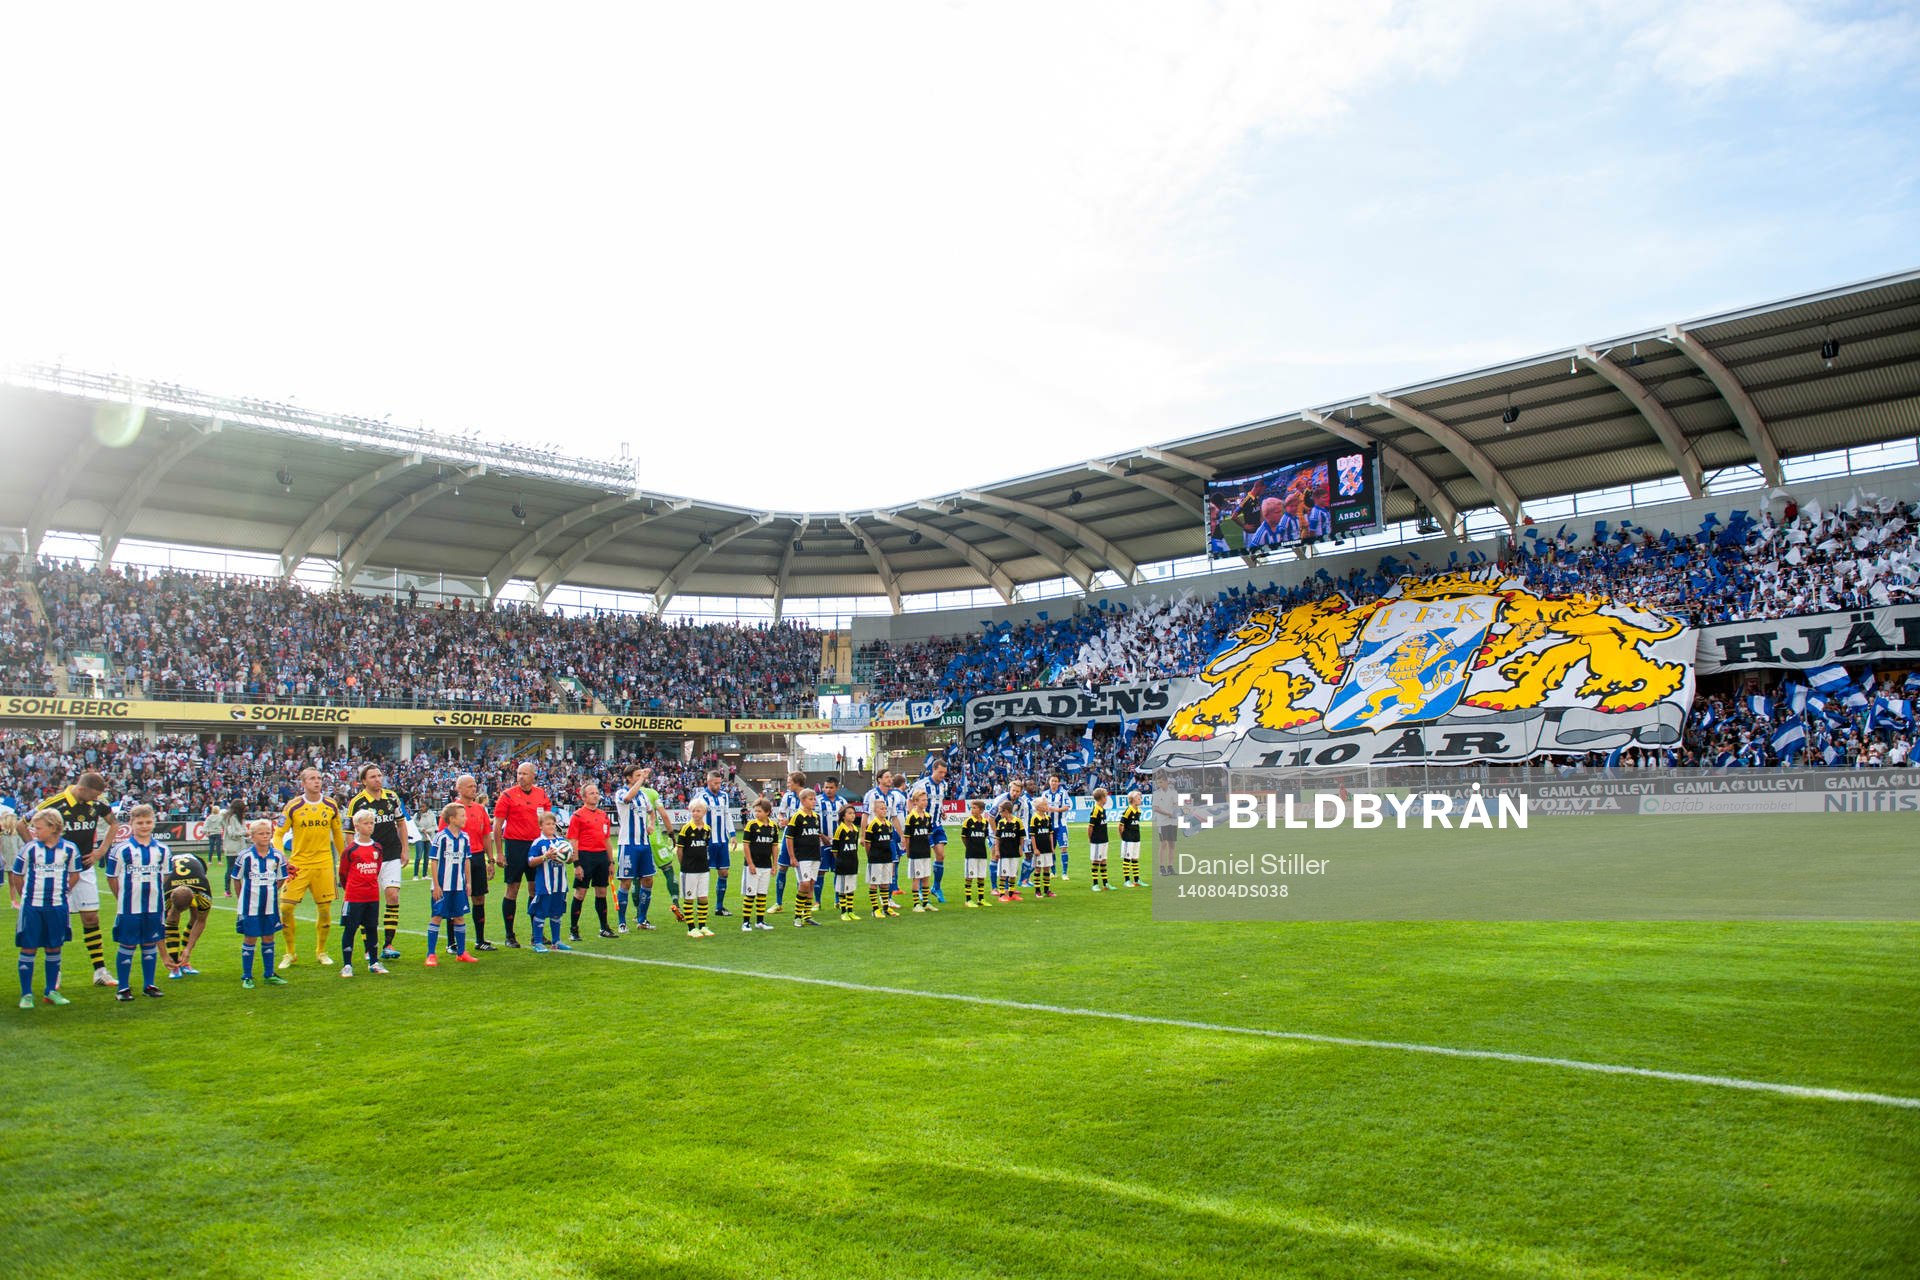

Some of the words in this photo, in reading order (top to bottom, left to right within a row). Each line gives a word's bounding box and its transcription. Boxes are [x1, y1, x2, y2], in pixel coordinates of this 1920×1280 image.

[7, 698, 129, 716] SOHLBERG
[972, 683, 1169, 725] STADENS
[250, 706, 351, 722] SOHLBERG
[450, 712, 532, 726] SOHLBERG
[615, 717, 683, 730] SOHLBERG
[1253, 743, 1361, 768] 110
[1373, 728, 1510, 758] ÅR
[1538, 785, 1592, 797] GAMLA
[1604, 783, 1656, 796] ULLEVI
[1673, 781, 1731, 794] GAMLA
[1747, 778, 1805, 792] ULLEVI
[1825, 776, 1888, 789] GAMLA
[175, 858, 192, 876] 3
